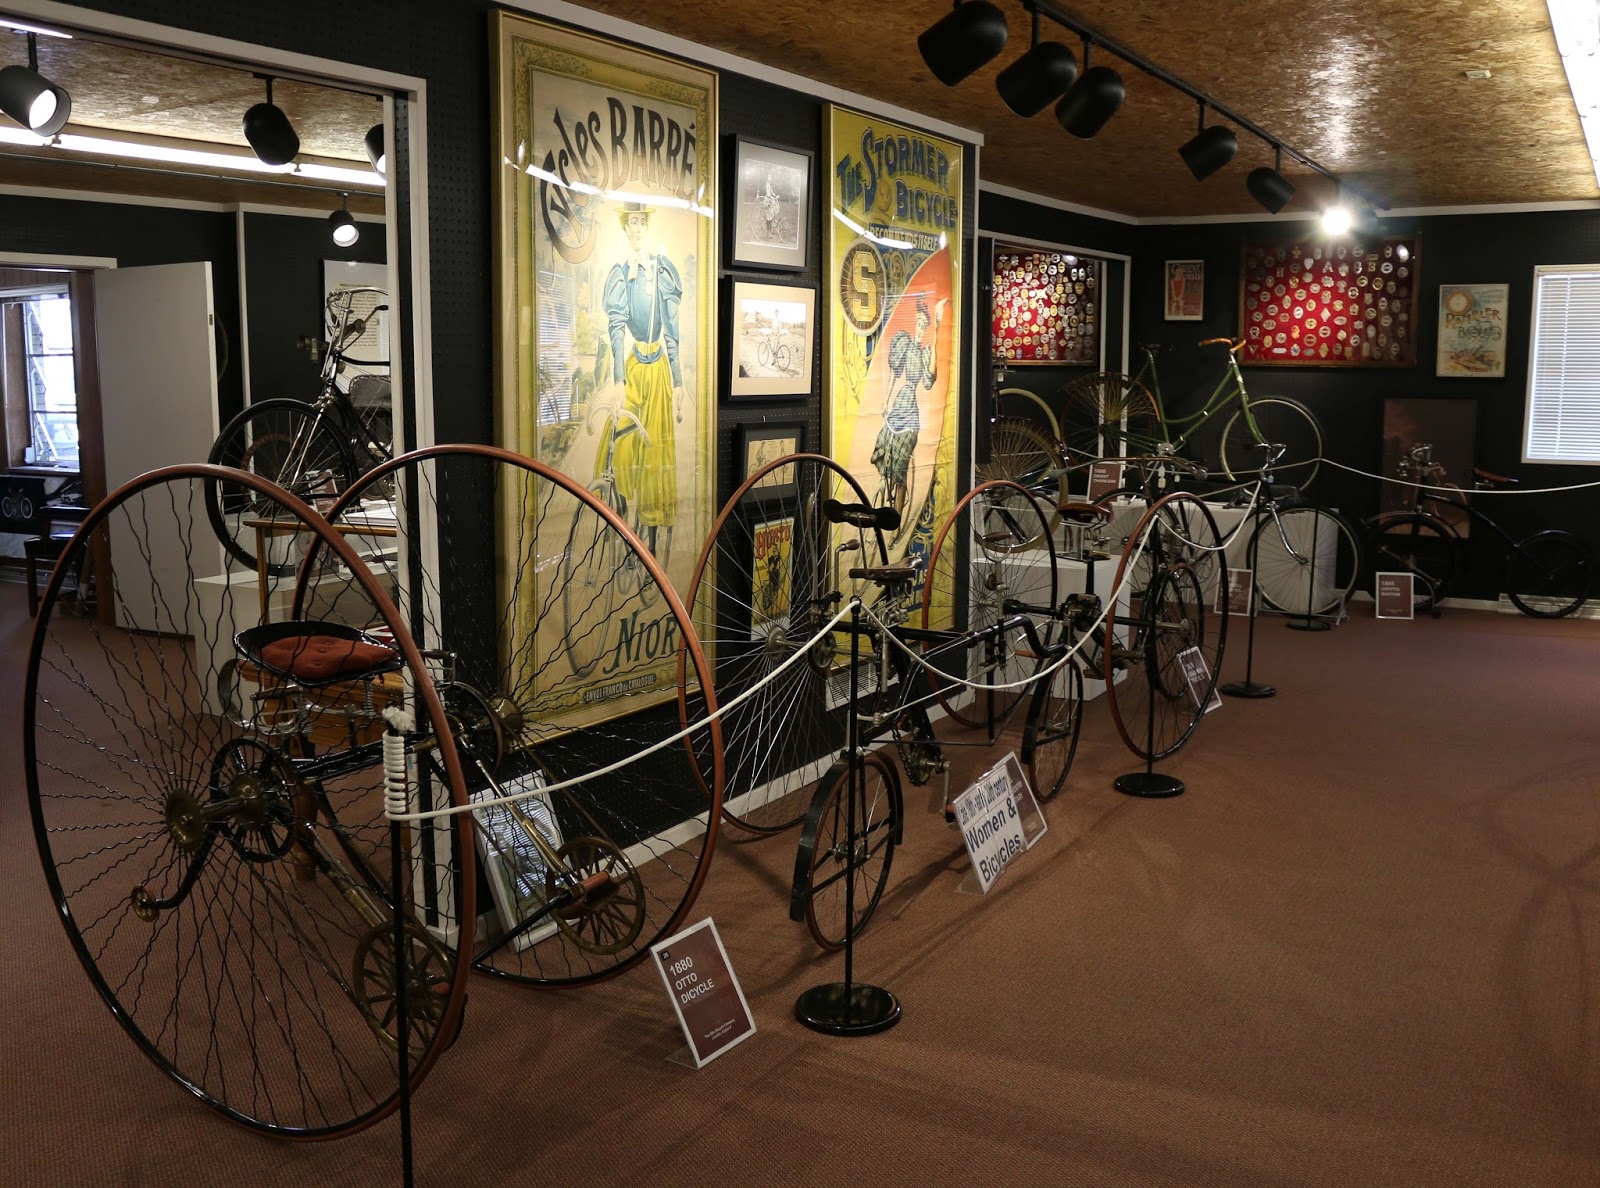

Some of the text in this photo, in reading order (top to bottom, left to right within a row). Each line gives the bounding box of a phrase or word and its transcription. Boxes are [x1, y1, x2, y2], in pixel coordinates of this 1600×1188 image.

[862, 127, 948, 214] STORMER
[602, 607, 680, 675] NIOR
[965, 797, 1017, 853] Women &
[979, 833, 1021, 883] Bicycles
[669, 956, 693, 976] 1880
[675, 972, 698, 990] OTTO
[680, 978, 715, 1004] DICYCLE
